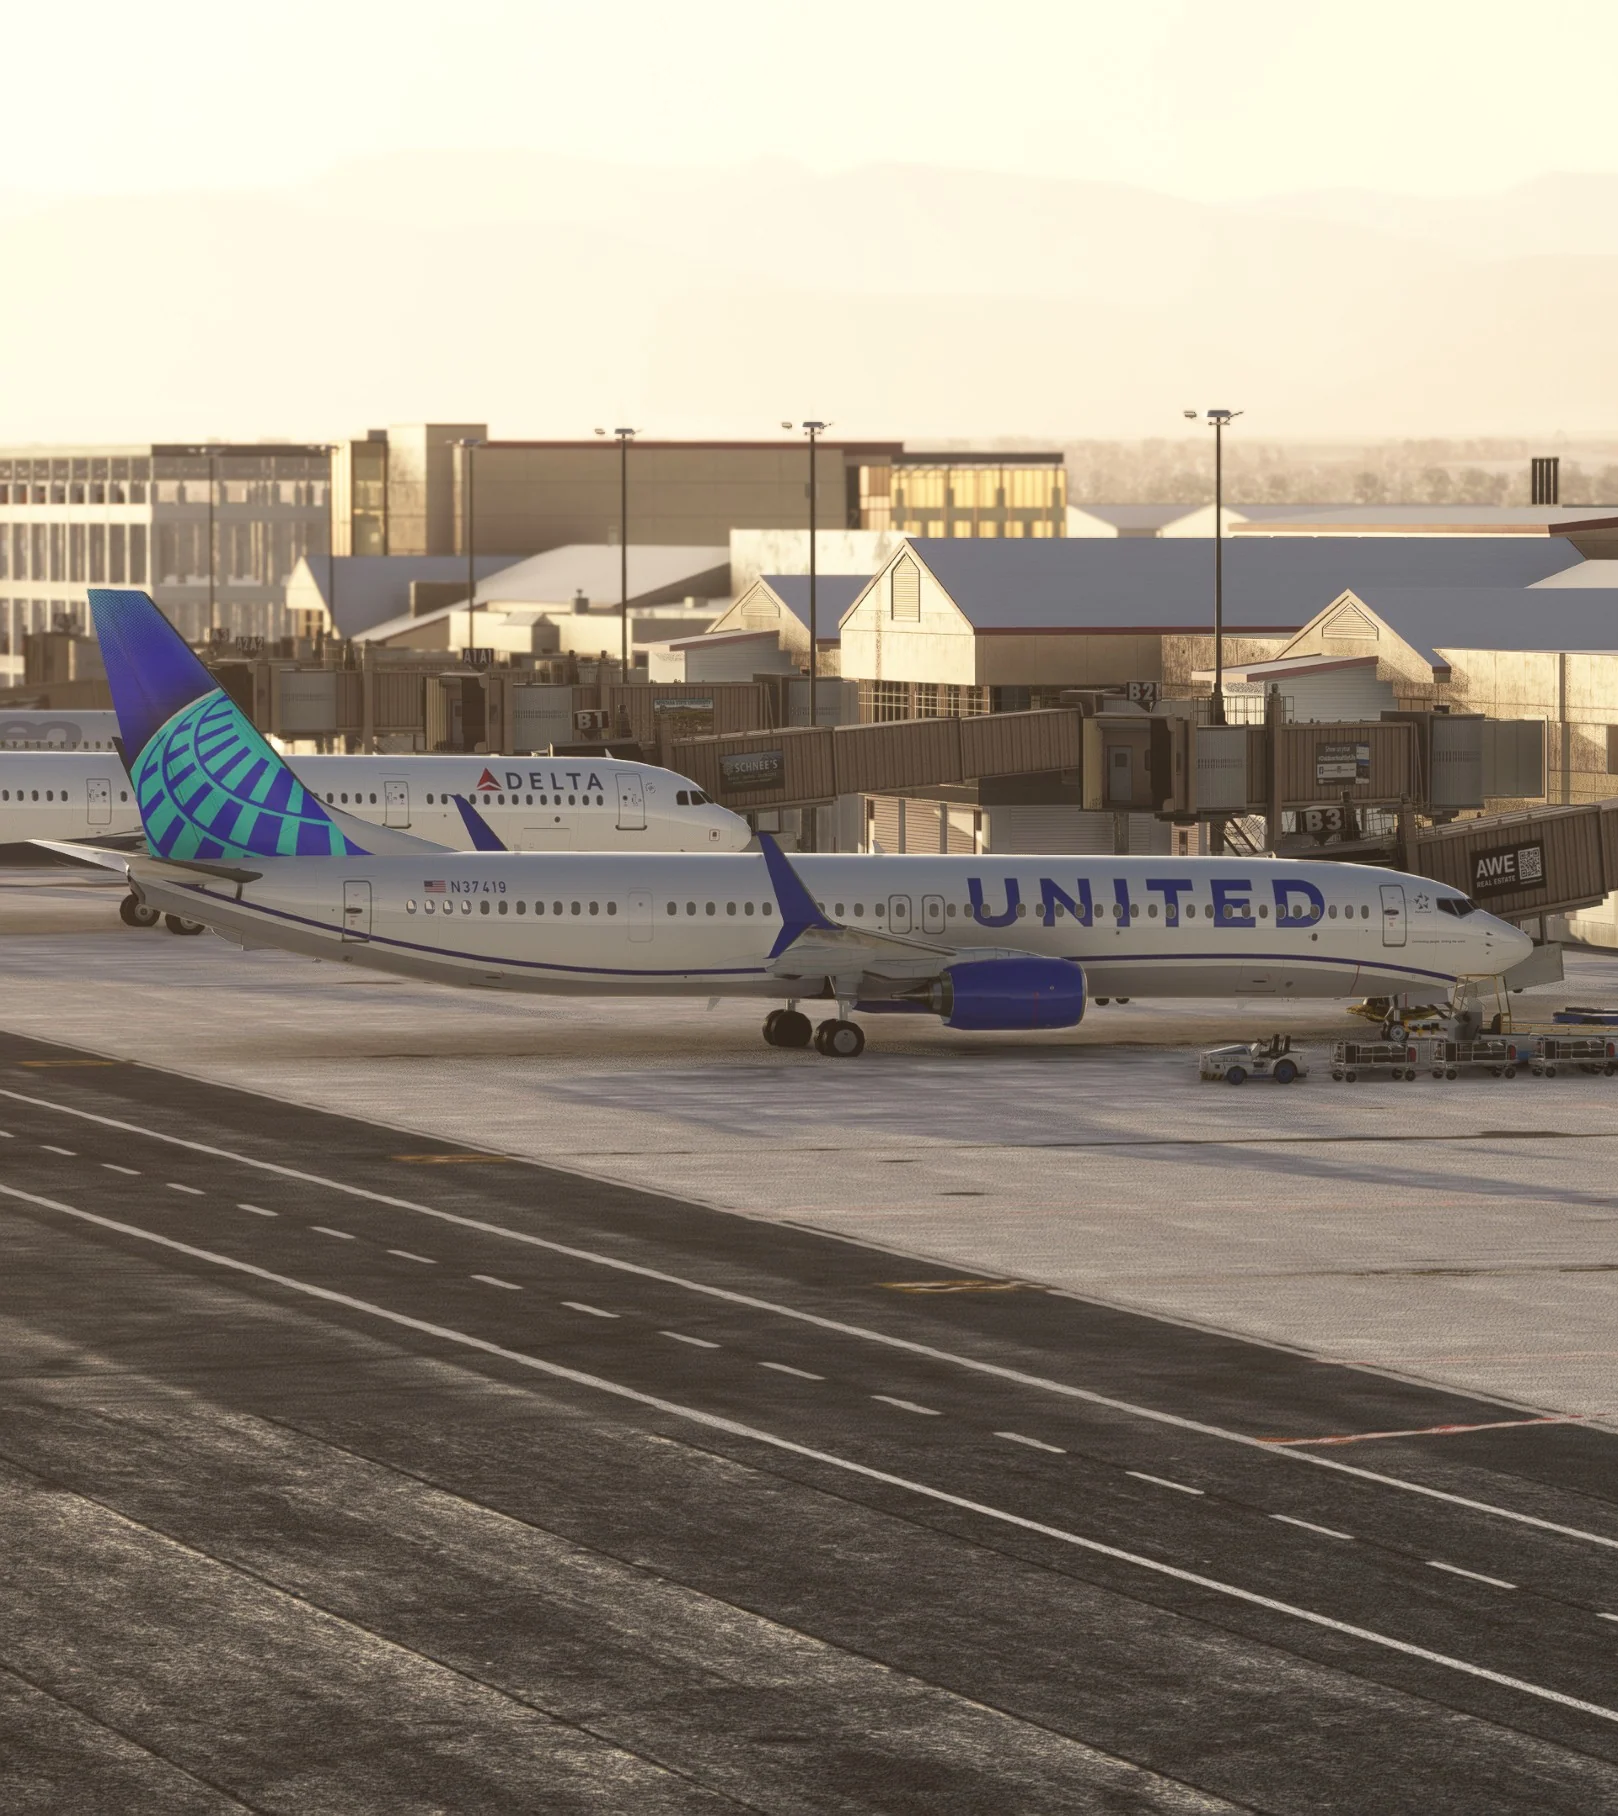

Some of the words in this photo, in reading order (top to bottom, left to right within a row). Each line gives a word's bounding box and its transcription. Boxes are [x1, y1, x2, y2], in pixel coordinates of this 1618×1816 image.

[1129, 683, 1154, 700] B2
[577, 711, 603, 729] B1
[734, 759, 778, 773] SCHNEE'S
[505, 772, 604, 790] DELTA
[1305, 808, 1342, 831] B3
[1476, 853, 1516, 879] AWE
[450, 881, 507, 894] N37419
[1476, 880, 1492, 889] REAL
[1493, 875, 1516, 885] ESTATE
[967, 878, 1325, 928] UNITED
